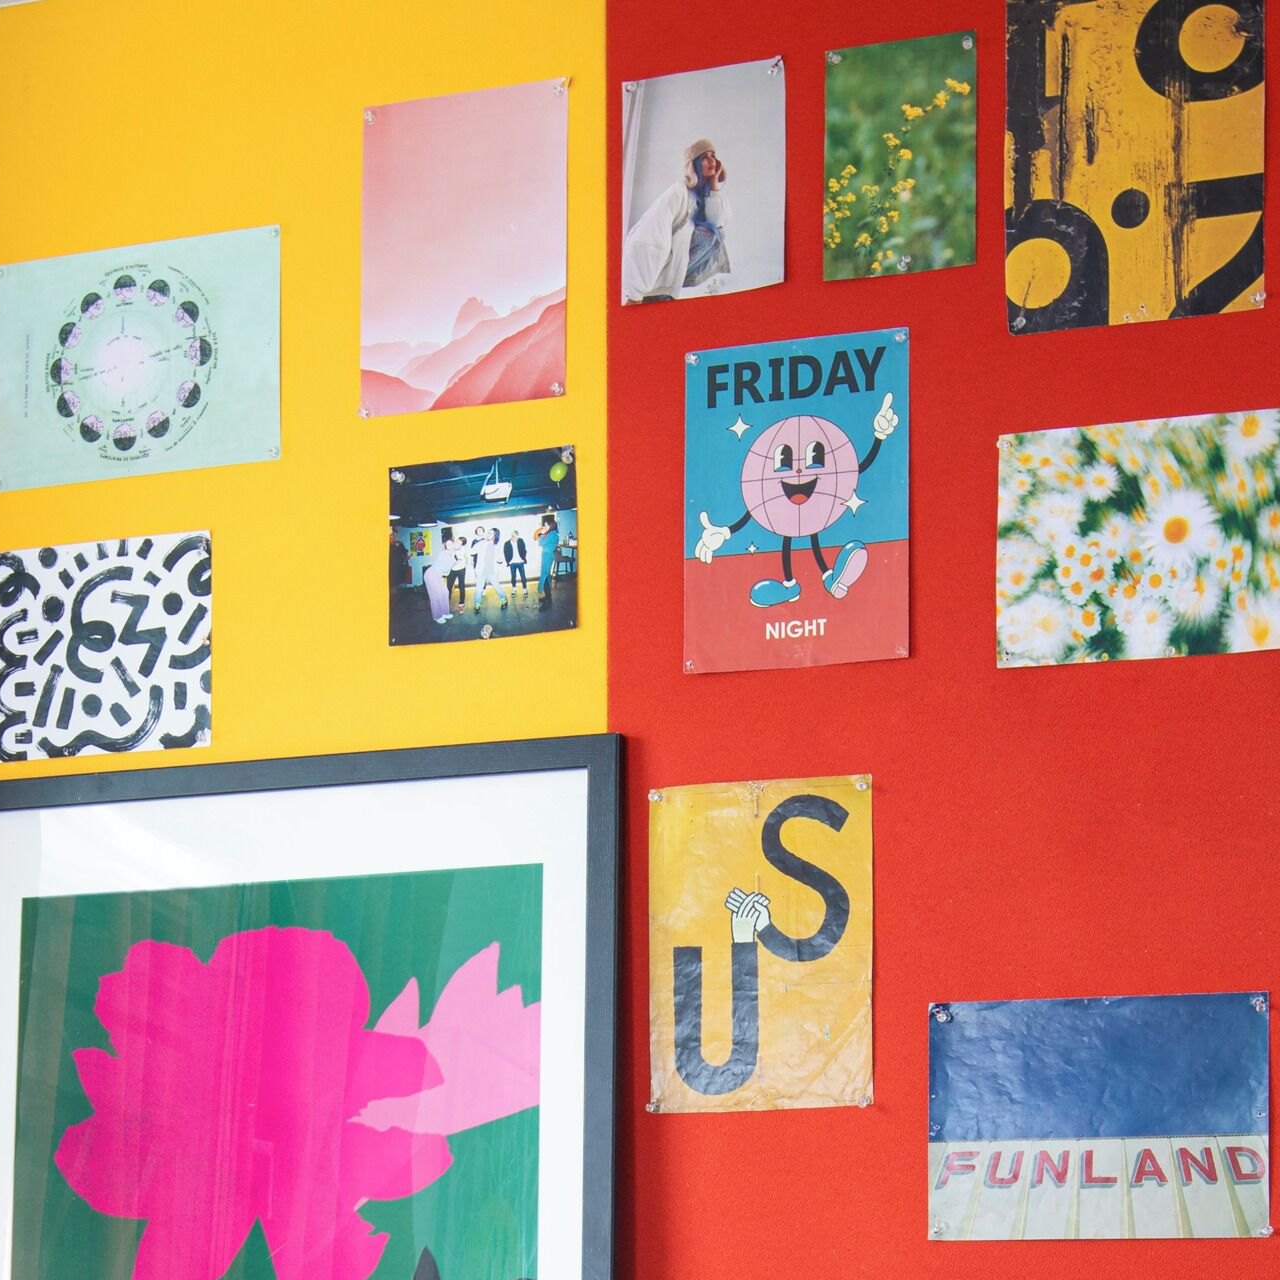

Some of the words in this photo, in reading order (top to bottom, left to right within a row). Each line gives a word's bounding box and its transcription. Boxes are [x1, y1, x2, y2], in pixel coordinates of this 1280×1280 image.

[706, 345, 887, 409] FRIDAY
[765, 617, 827, 640] NIGHT
[935, 1145, 1266, 1189] FUNLAND
